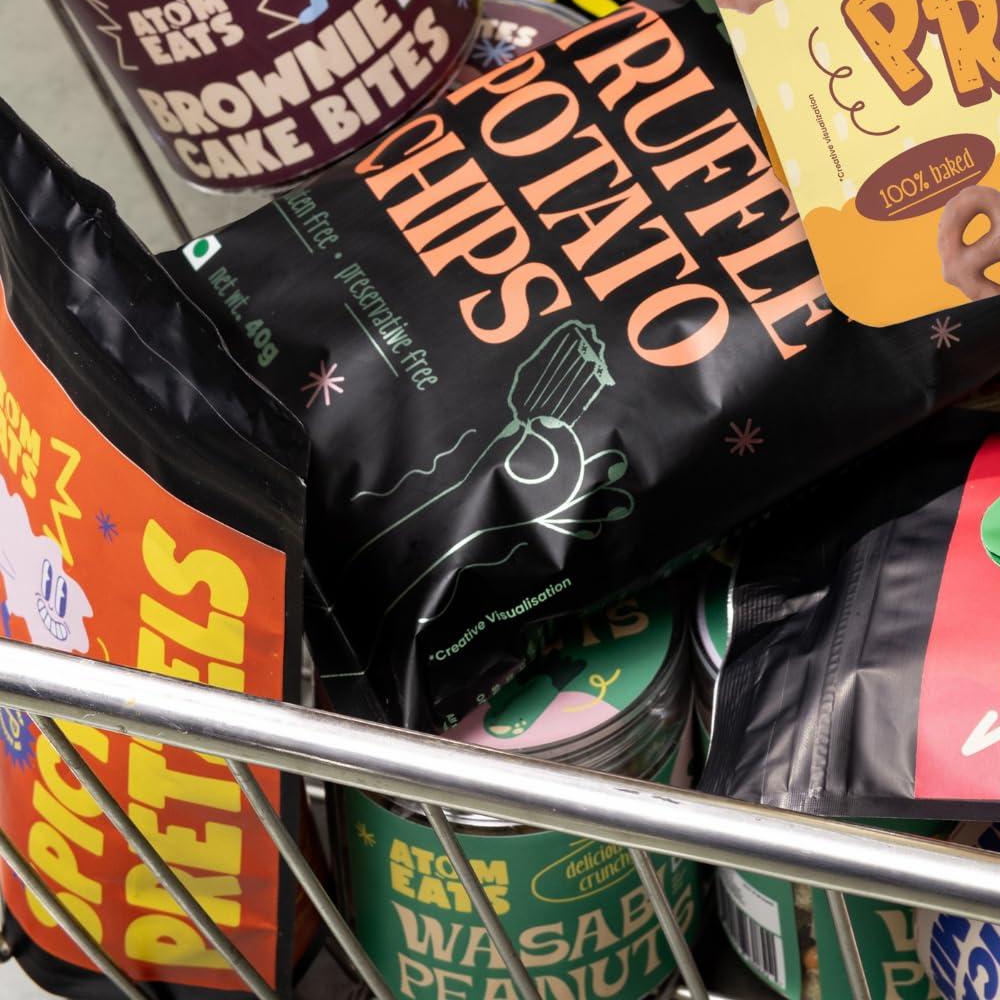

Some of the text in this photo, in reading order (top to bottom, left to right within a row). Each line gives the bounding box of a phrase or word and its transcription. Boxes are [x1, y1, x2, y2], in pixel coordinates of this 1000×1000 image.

[140, 11, 244, 65] EATS
[173, 7, 450, 179] CAKE BITES
[447, 50, 729, 367] POTATO
[556, 2, 834, 360] TRUFFLE
[880, 147, 974, 208] 100% baked
[355, 113, 572, 344] CHIPS
[208, 266, 233, 297] net
[244, 318, 280, 367] 40g
[304, 211, 339, 249] free
[334, 262, 412, 354] preservative
[400, 349, 438, 391] free
[485, 577, 572, 623] Visualisation
[389, 839, 509, 886] ATOM
[390, 865, 510, 915] EATS
